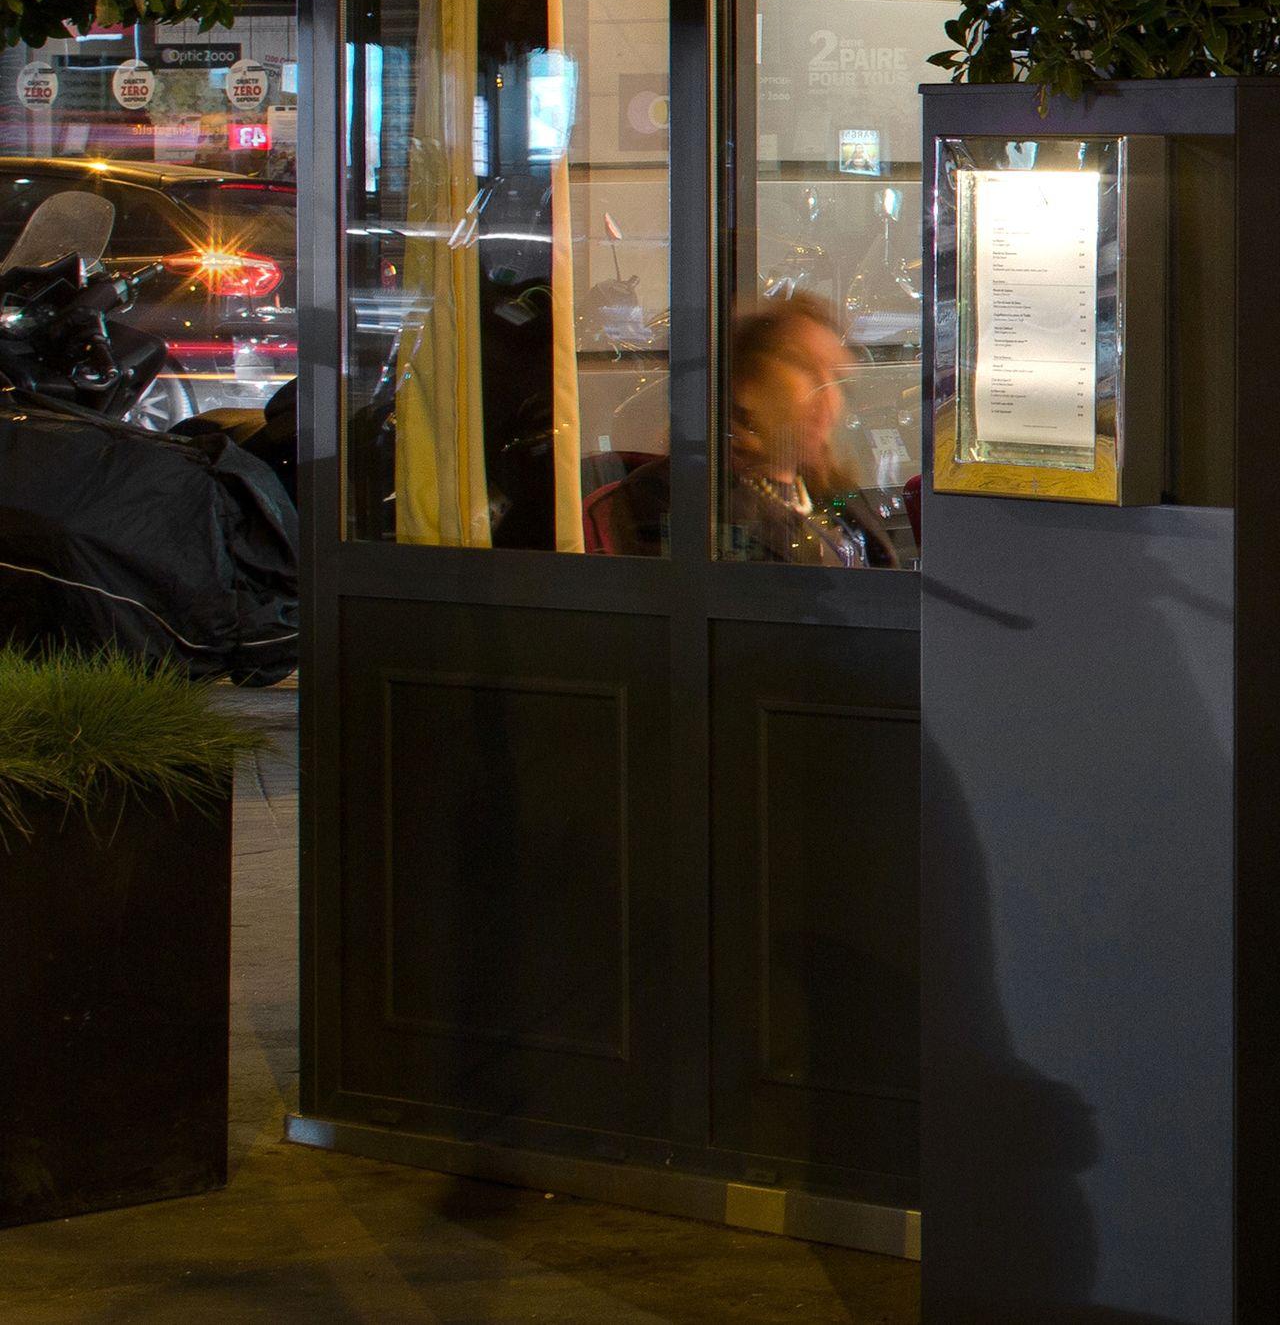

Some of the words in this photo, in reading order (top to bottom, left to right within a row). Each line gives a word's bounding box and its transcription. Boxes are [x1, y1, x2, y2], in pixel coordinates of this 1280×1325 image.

[839, 47, 909, 71] PAIRE
[808, 72, 856, 86] POUR
[121, 85, 149, 96] ZERO
[233, 85, 262, 96] ZERO
